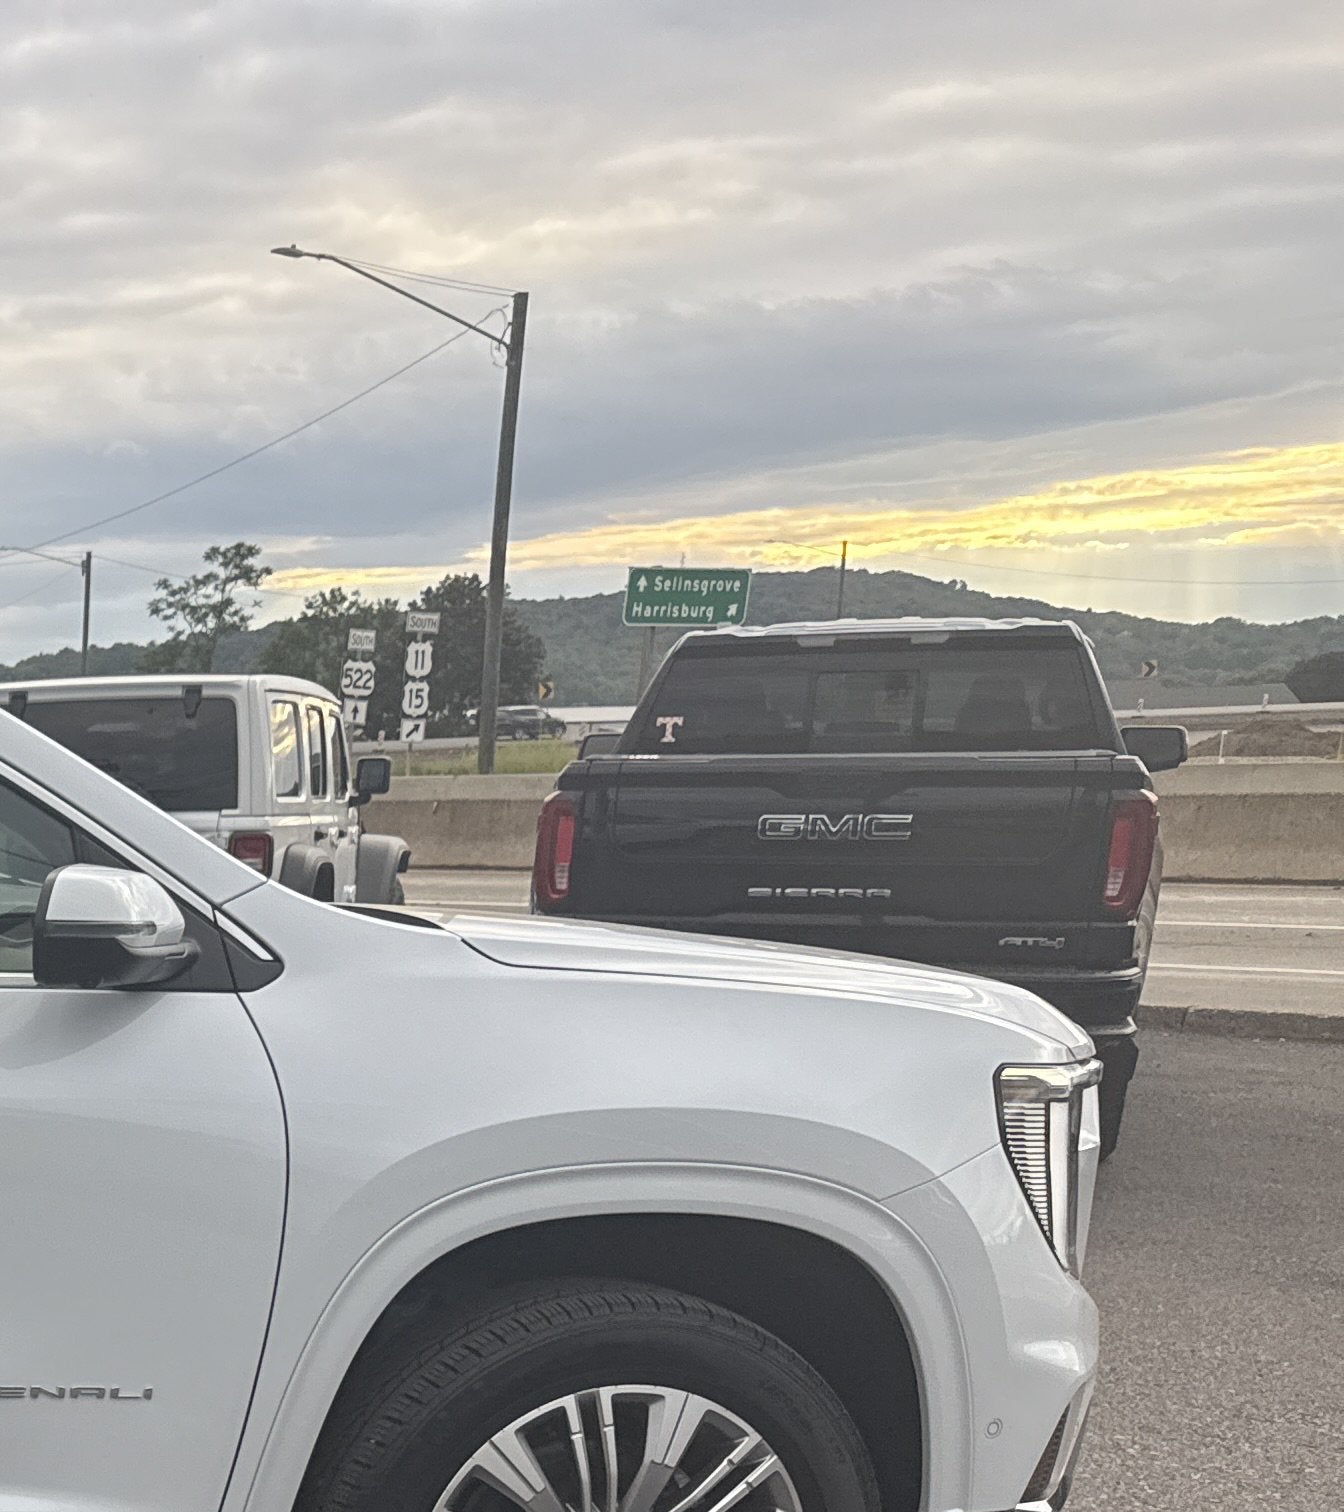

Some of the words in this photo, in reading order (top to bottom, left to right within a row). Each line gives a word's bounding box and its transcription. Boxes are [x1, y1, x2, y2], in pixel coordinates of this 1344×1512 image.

[653, 575, 741, 597] Selinsgrove
[409, 615, 437, 629] SOUTH
[632, 601, 715, 622] Harrisburg
[351, 632, 374, 647] SOUTH
[414, 649, 426, 671] 11
[343, 668, 373, 690] 522
[408, 687, 425, 709] 15
[757, 813, 914, 841] GMC
